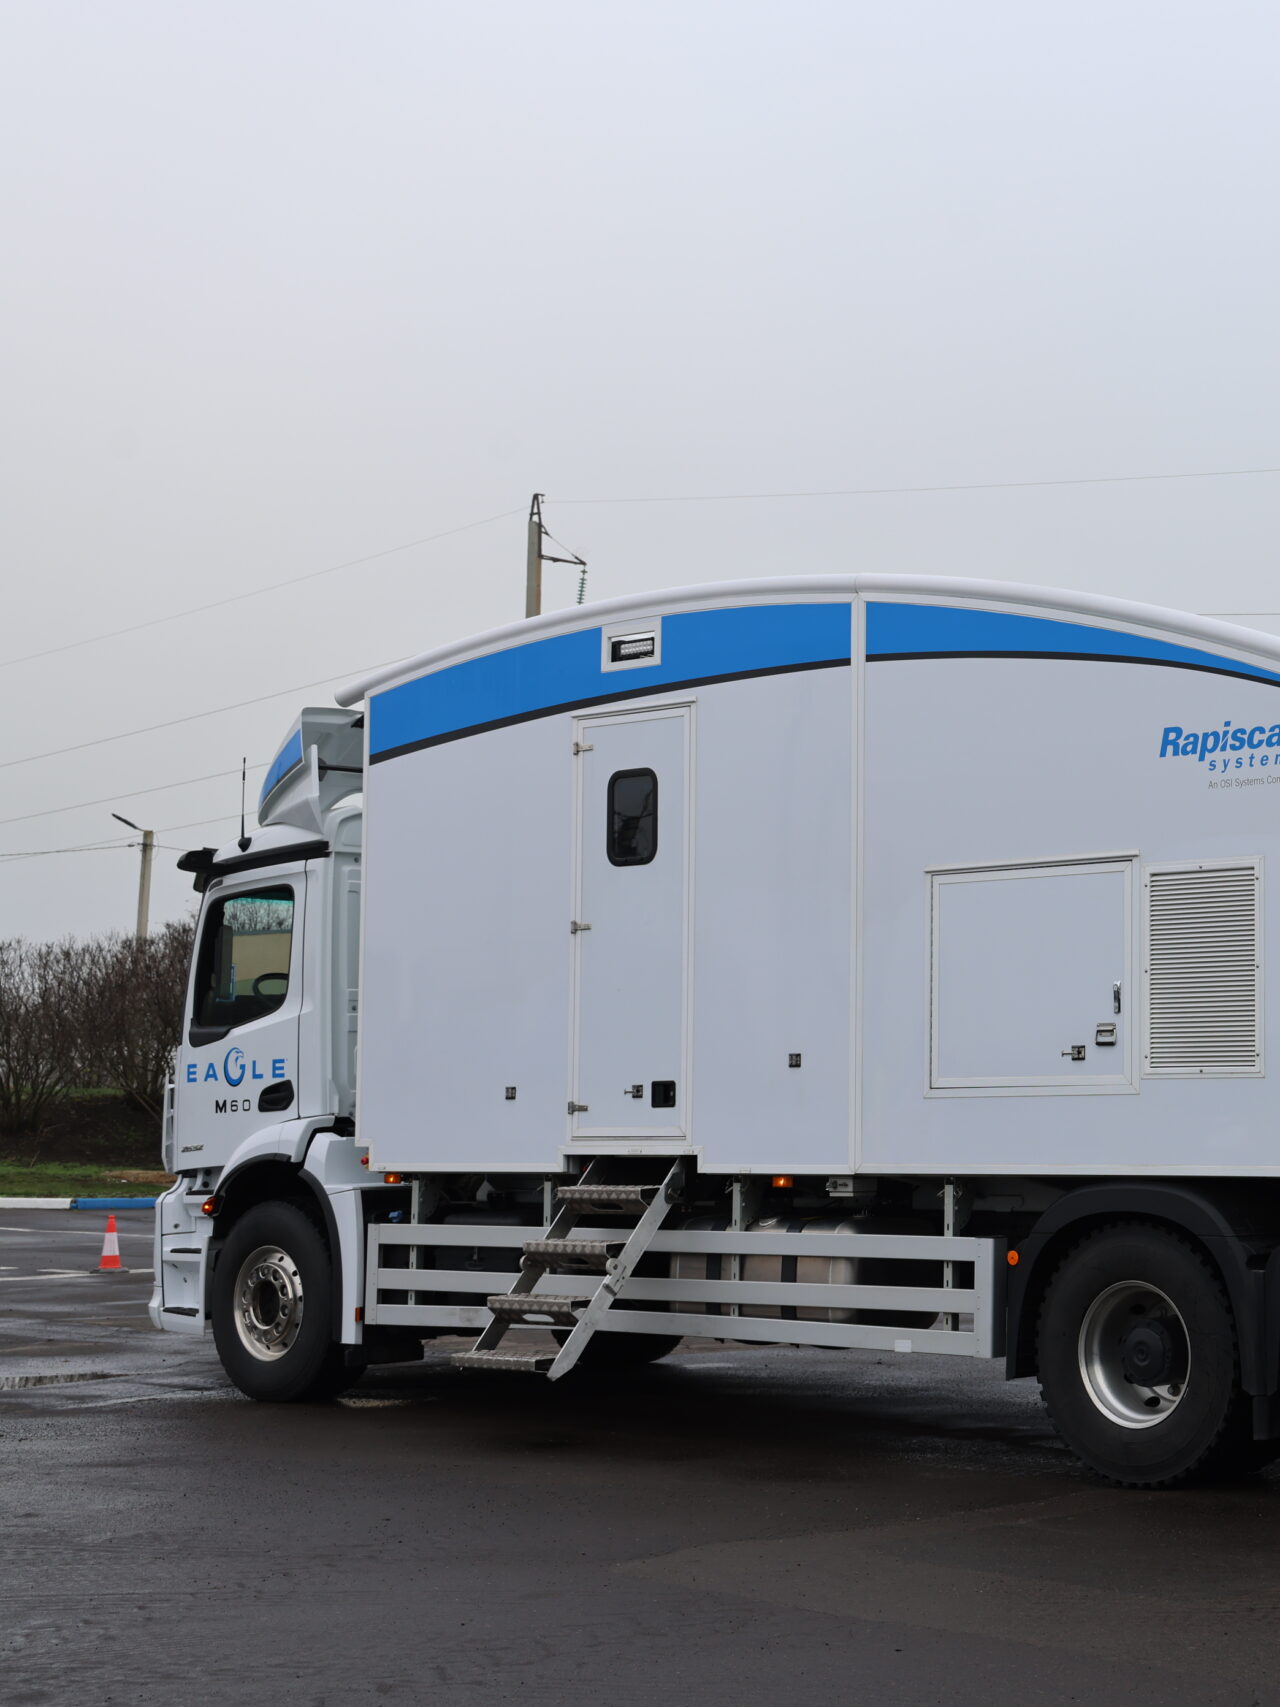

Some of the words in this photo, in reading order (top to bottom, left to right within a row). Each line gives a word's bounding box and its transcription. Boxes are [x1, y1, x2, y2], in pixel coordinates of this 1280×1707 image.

[1208, 780, 1218, 789] An
[1220, 778, 1233, 789] OSI
[1235, 776, 1265, 788] Systems
[187, 1047, 285, 1087] EAGLE
[215, 1099, 251, 1113] M60
